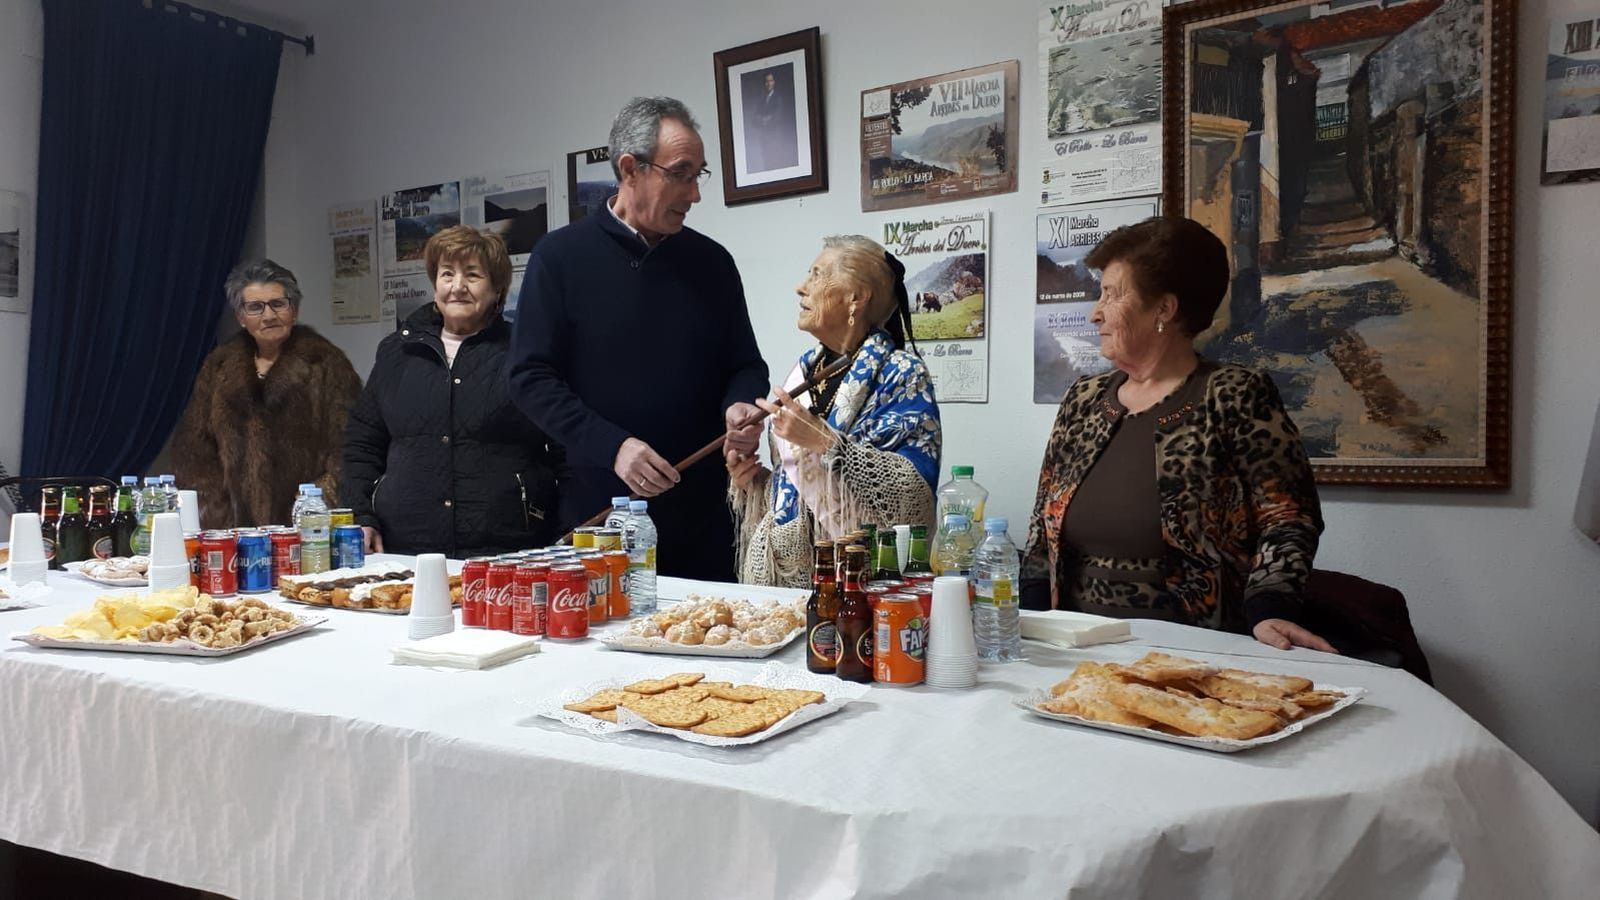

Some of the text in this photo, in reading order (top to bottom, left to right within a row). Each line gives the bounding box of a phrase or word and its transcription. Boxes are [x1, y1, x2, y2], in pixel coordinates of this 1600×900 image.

[939, 80, 963, 103] VII
[884, 219, 934, 245] IX Marcha
[895, 225, 980, 256] Arribes del Duero
[1048, 213, 1099, 250] XI Marcha
[1070, 231, 1101, 247] ARRIBES
